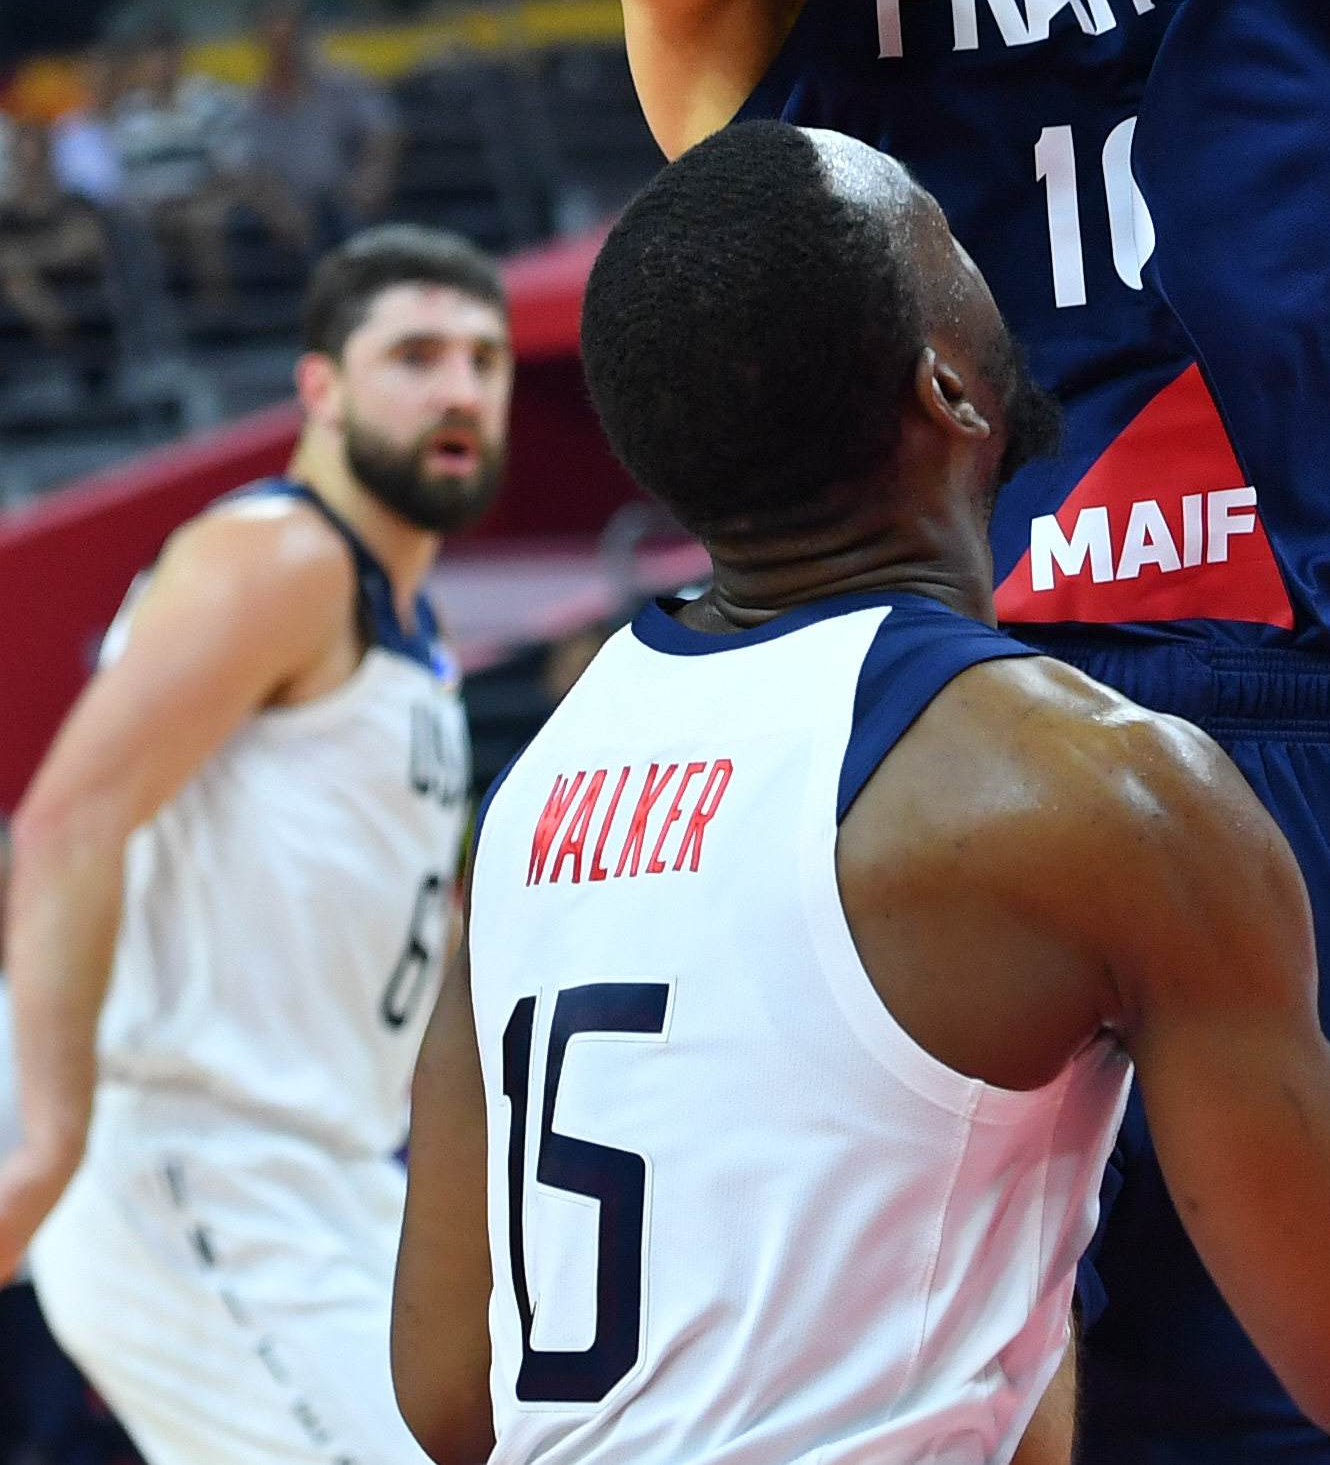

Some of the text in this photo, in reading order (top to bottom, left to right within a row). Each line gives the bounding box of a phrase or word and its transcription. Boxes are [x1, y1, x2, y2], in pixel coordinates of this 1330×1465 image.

[1030, 485, 1258, 592] MAIF
[527, 759, 733, 887] WALKER
[502, 981, 672, 1405] 15
